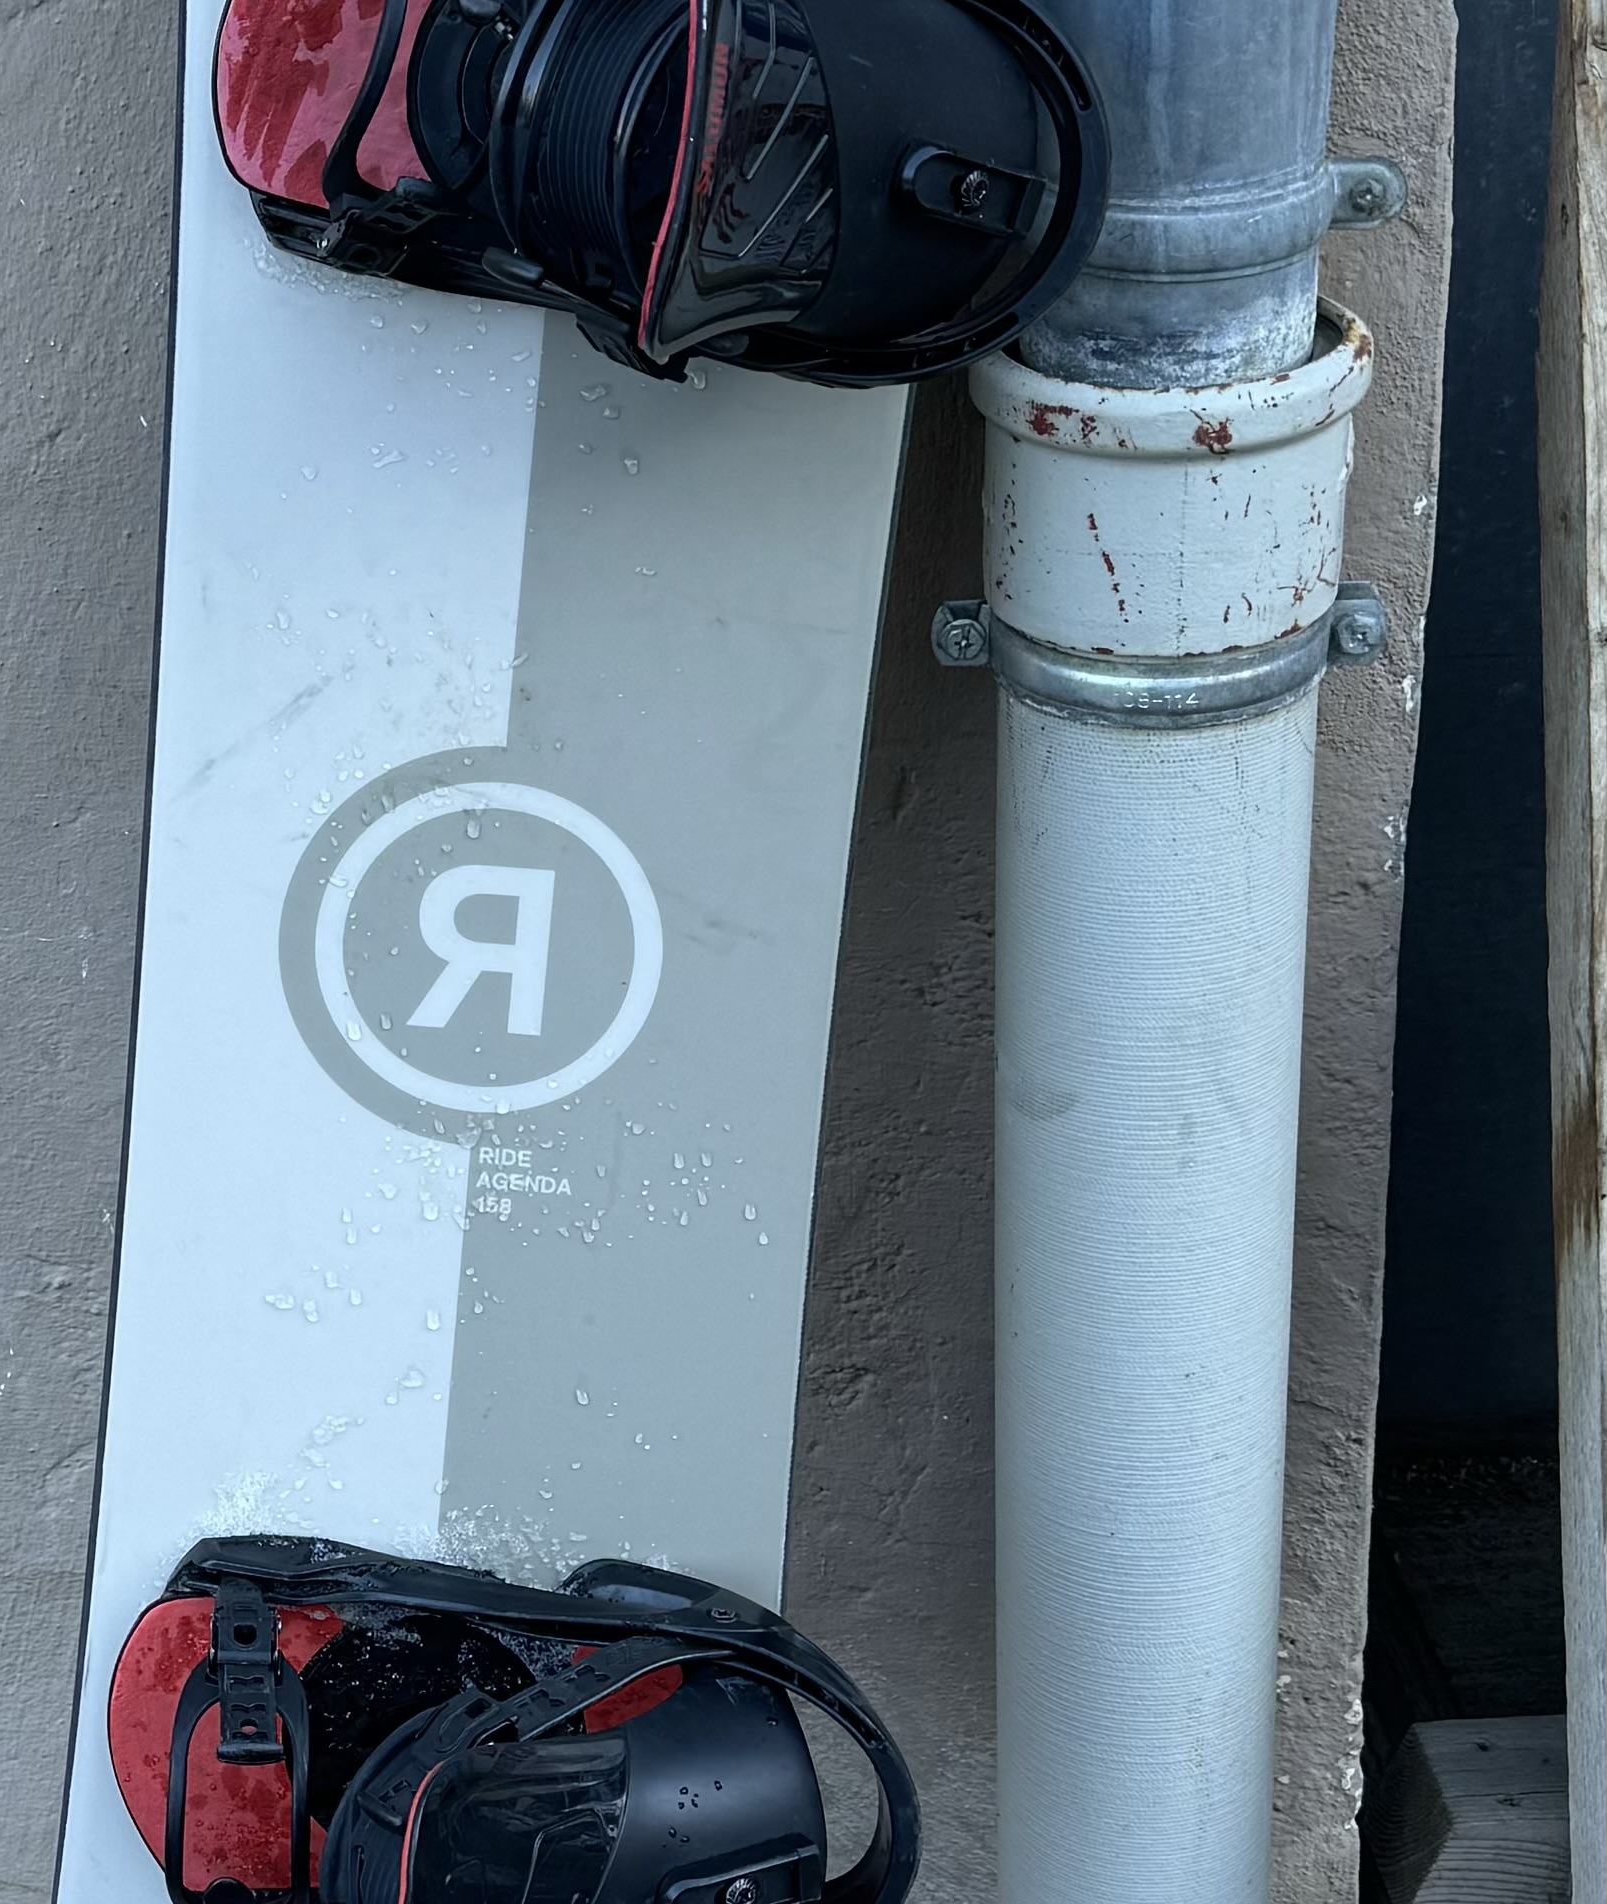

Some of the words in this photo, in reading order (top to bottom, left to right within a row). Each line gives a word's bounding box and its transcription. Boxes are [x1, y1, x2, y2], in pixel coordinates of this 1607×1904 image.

[478, 1147, 533, 1168] RIDE
[476, 1170, 572, 1196] AGENDA
[477, 1195, 513, 1215] 158
